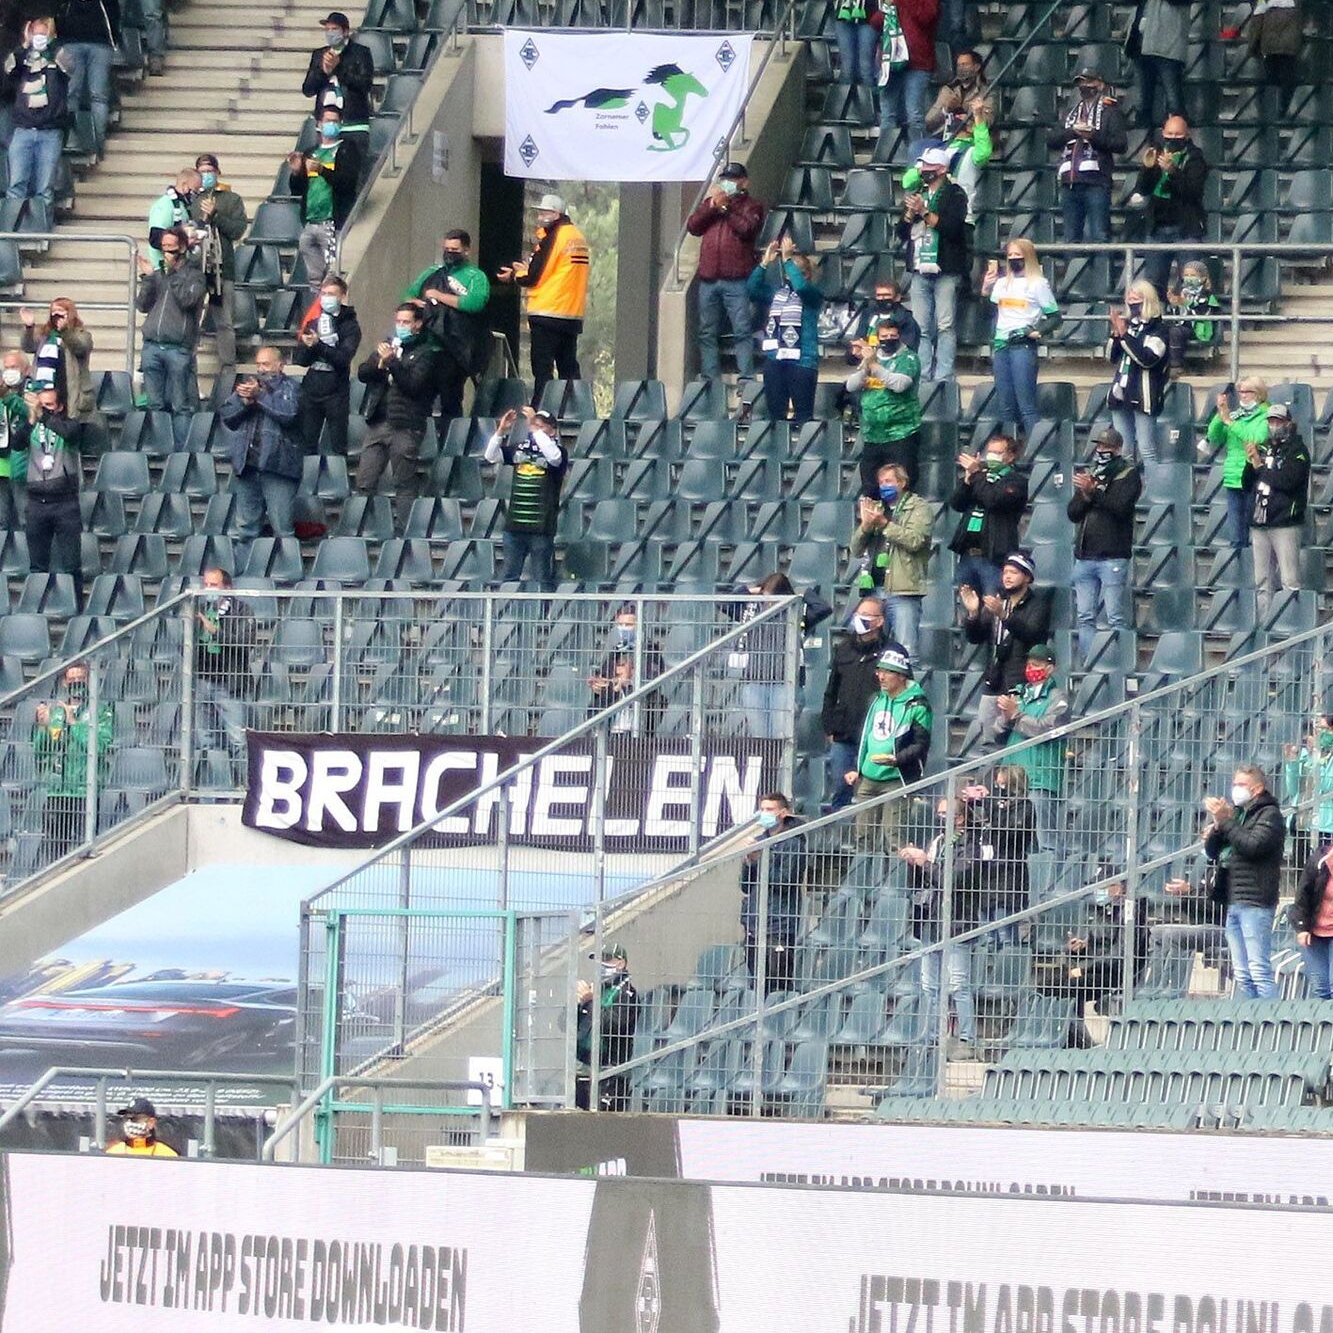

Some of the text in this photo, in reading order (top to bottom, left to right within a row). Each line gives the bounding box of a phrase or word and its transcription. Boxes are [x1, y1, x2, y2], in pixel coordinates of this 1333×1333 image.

[256, 750, 763, 837] BRACHELEN
[479, 1072, 494, 1089] 13
[100, 1224, 469, 1333] JETZT IM APP STORE DOWNLOADEN
